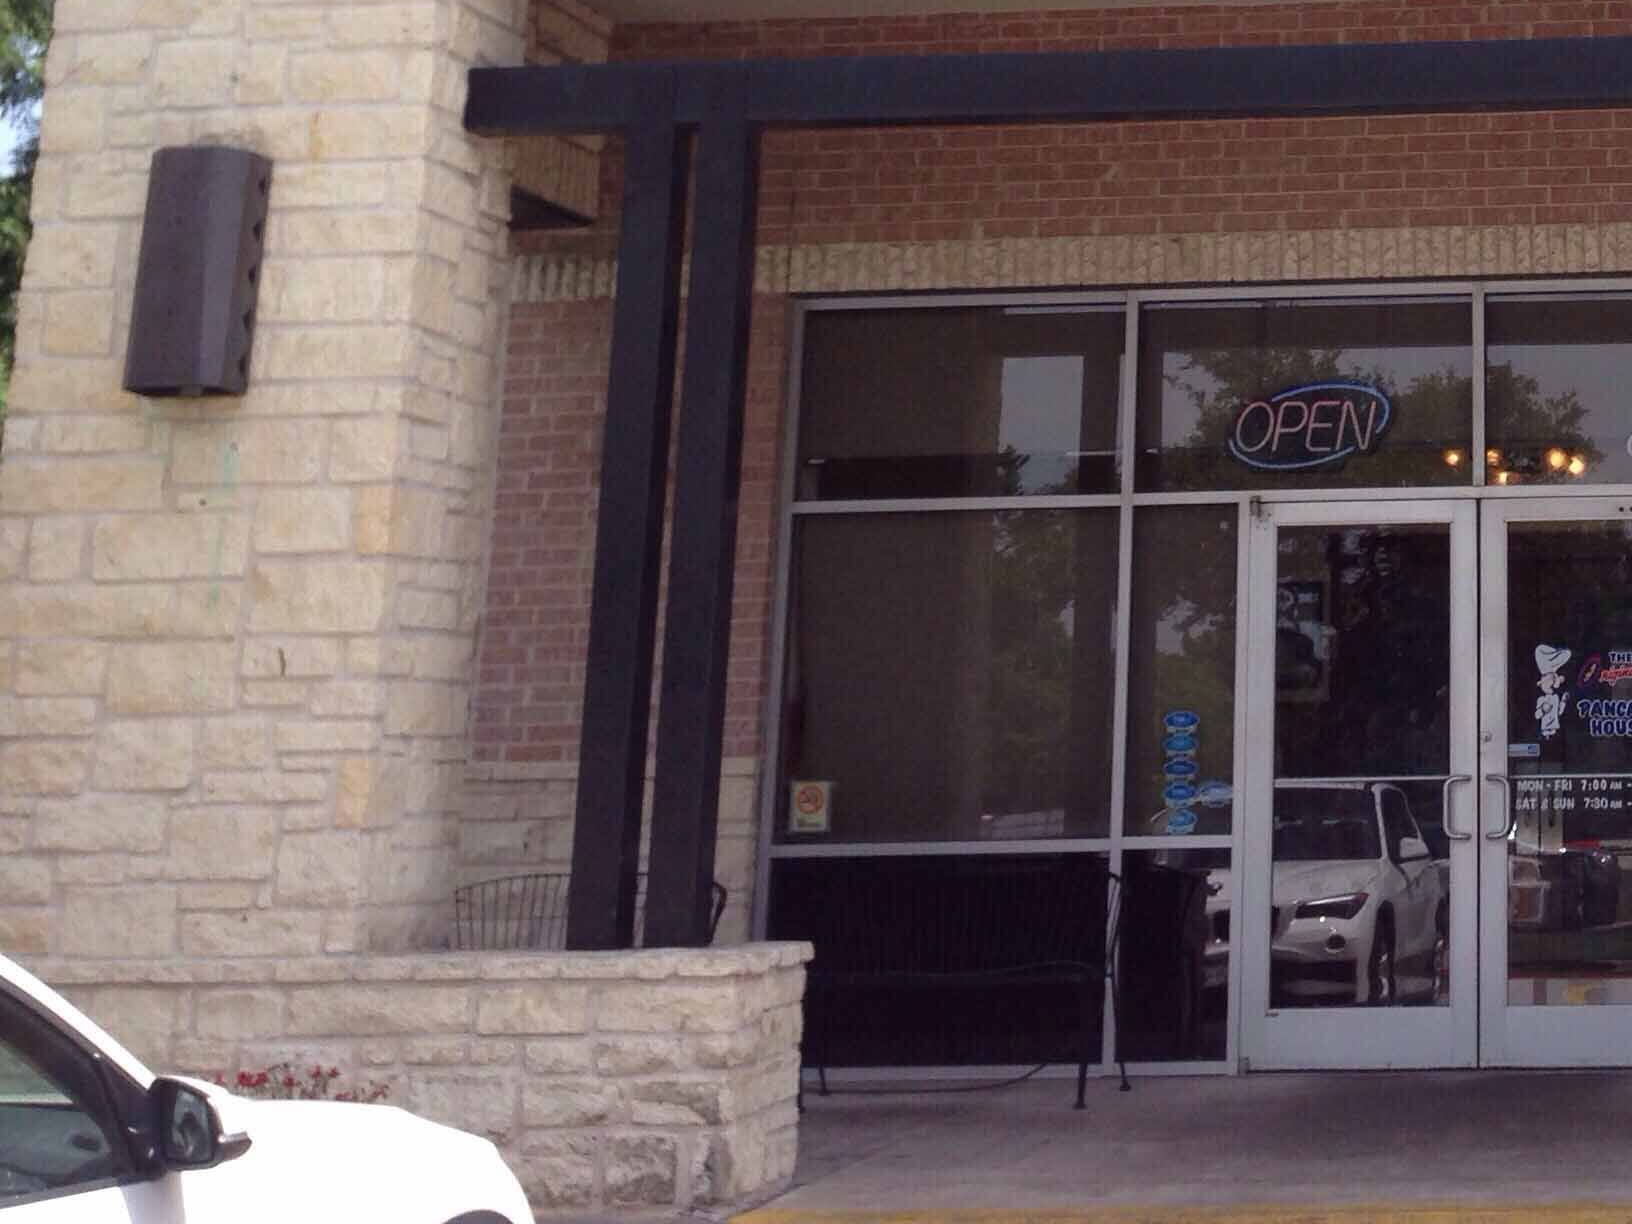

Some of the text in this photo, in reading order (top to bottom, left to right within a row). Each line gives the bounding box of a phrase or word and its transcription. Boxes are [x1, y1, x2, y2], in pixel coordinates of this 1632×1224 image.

[1236, 401, 1376, 451] OPEN
[1517, 779, 1544, 791] MON
[1554, 779, 1573, 791] FRI
[1515, 798, 1537, 810] SAT
[1553, 798, 1575, 809] SUN
[1584, 798, 1608, 809] 7:30
